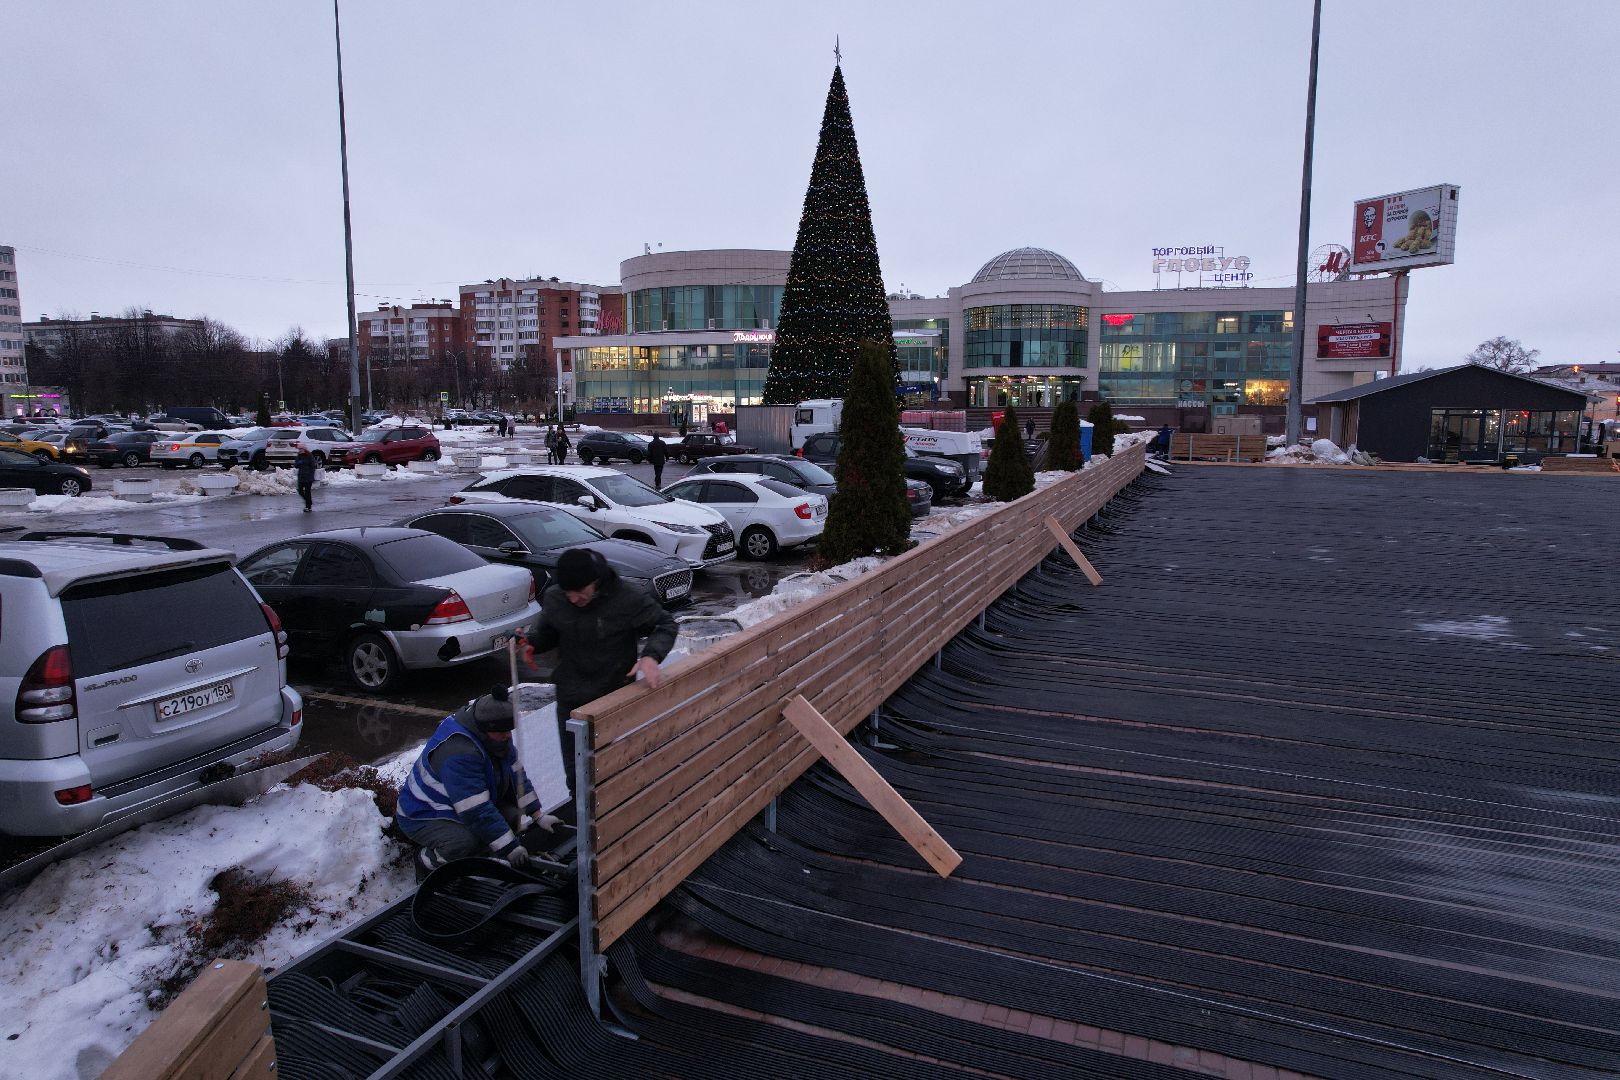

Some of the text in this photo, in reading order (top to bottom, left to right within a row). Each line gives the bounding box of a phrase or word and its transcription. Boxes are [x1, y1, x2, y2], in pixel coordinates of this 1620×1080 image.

[1360, 234, 1377, 242] KFC
[1152, 245, 1215, 256] ТОРГОВЫЙ
[1152, 256, 1251, 273] ГЛОБУС
[1214, 273, 1254, 283] ЦЕНТР
[1178, 400, 1205, 408] КАССЫ
[105, 675, 138, 687] PRADO
